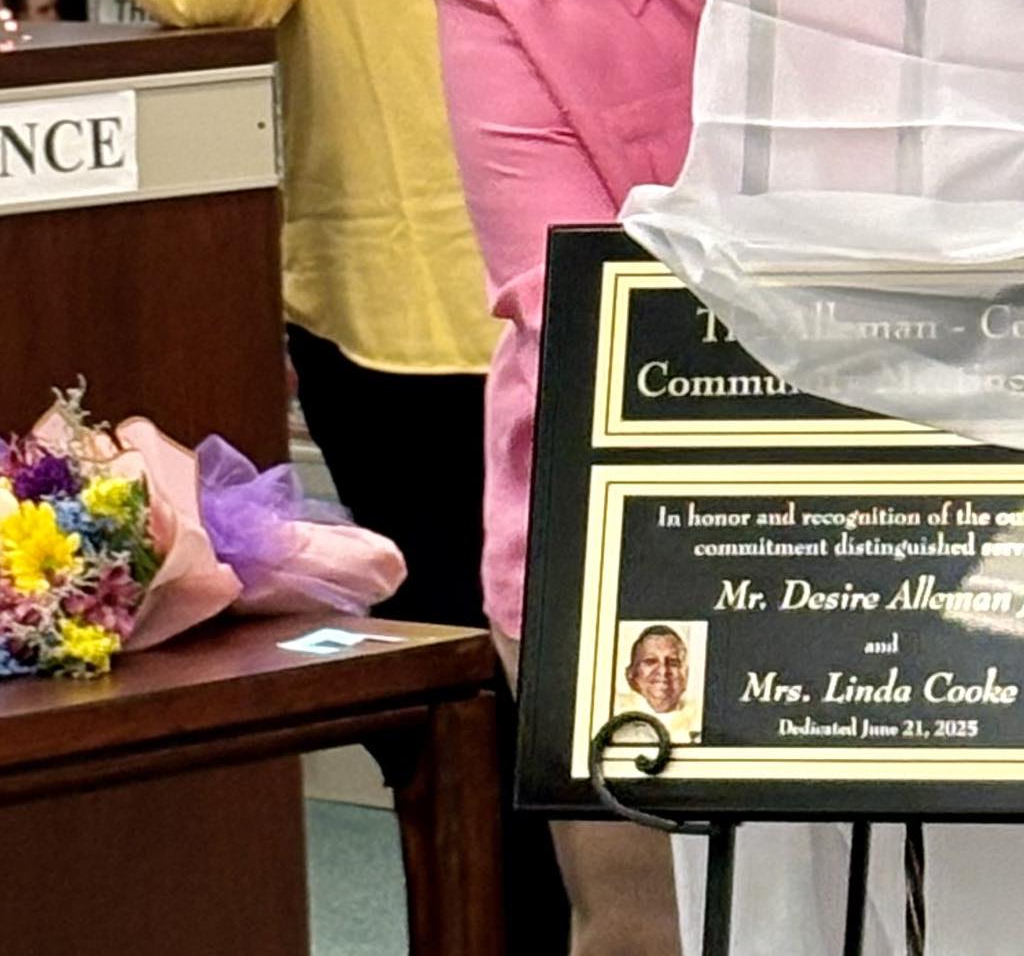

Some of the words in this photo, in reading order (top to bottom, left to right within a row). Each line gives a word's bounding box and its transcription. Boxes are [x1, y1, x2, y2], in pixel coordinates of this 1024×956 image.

[0, 116, 125, 178] NCE
[637, 360, 864, 399] Commu
[658, 505, 682, 528] In
[687, 501, 752, 527] honor
[756, 501, 797, 526] and
[802, 506, 921, 531] recognition
[927, 501, 952, 526] of
[956, 501, 991, 526] the
[694, 536, 829, 557] commitment
[834, 531, 976, 562] distinguished
[713, 579, 767, 611] Mr.
[778, 579, 881, 610] Desire
[885, 574, 1012, 613] Alleman
[864, 631, 899, 654] and
[739, 672, 811, 704] Mrs.
[821, 666, 912, 704] Linda
[923, 666, 1020, 705] Cooke
[778, 715, 857, 737] Dedicated
[860, 718, 899, 739] June
[901, 718, 930, 739] 21,
[935, 718, 979, 737] 2025
